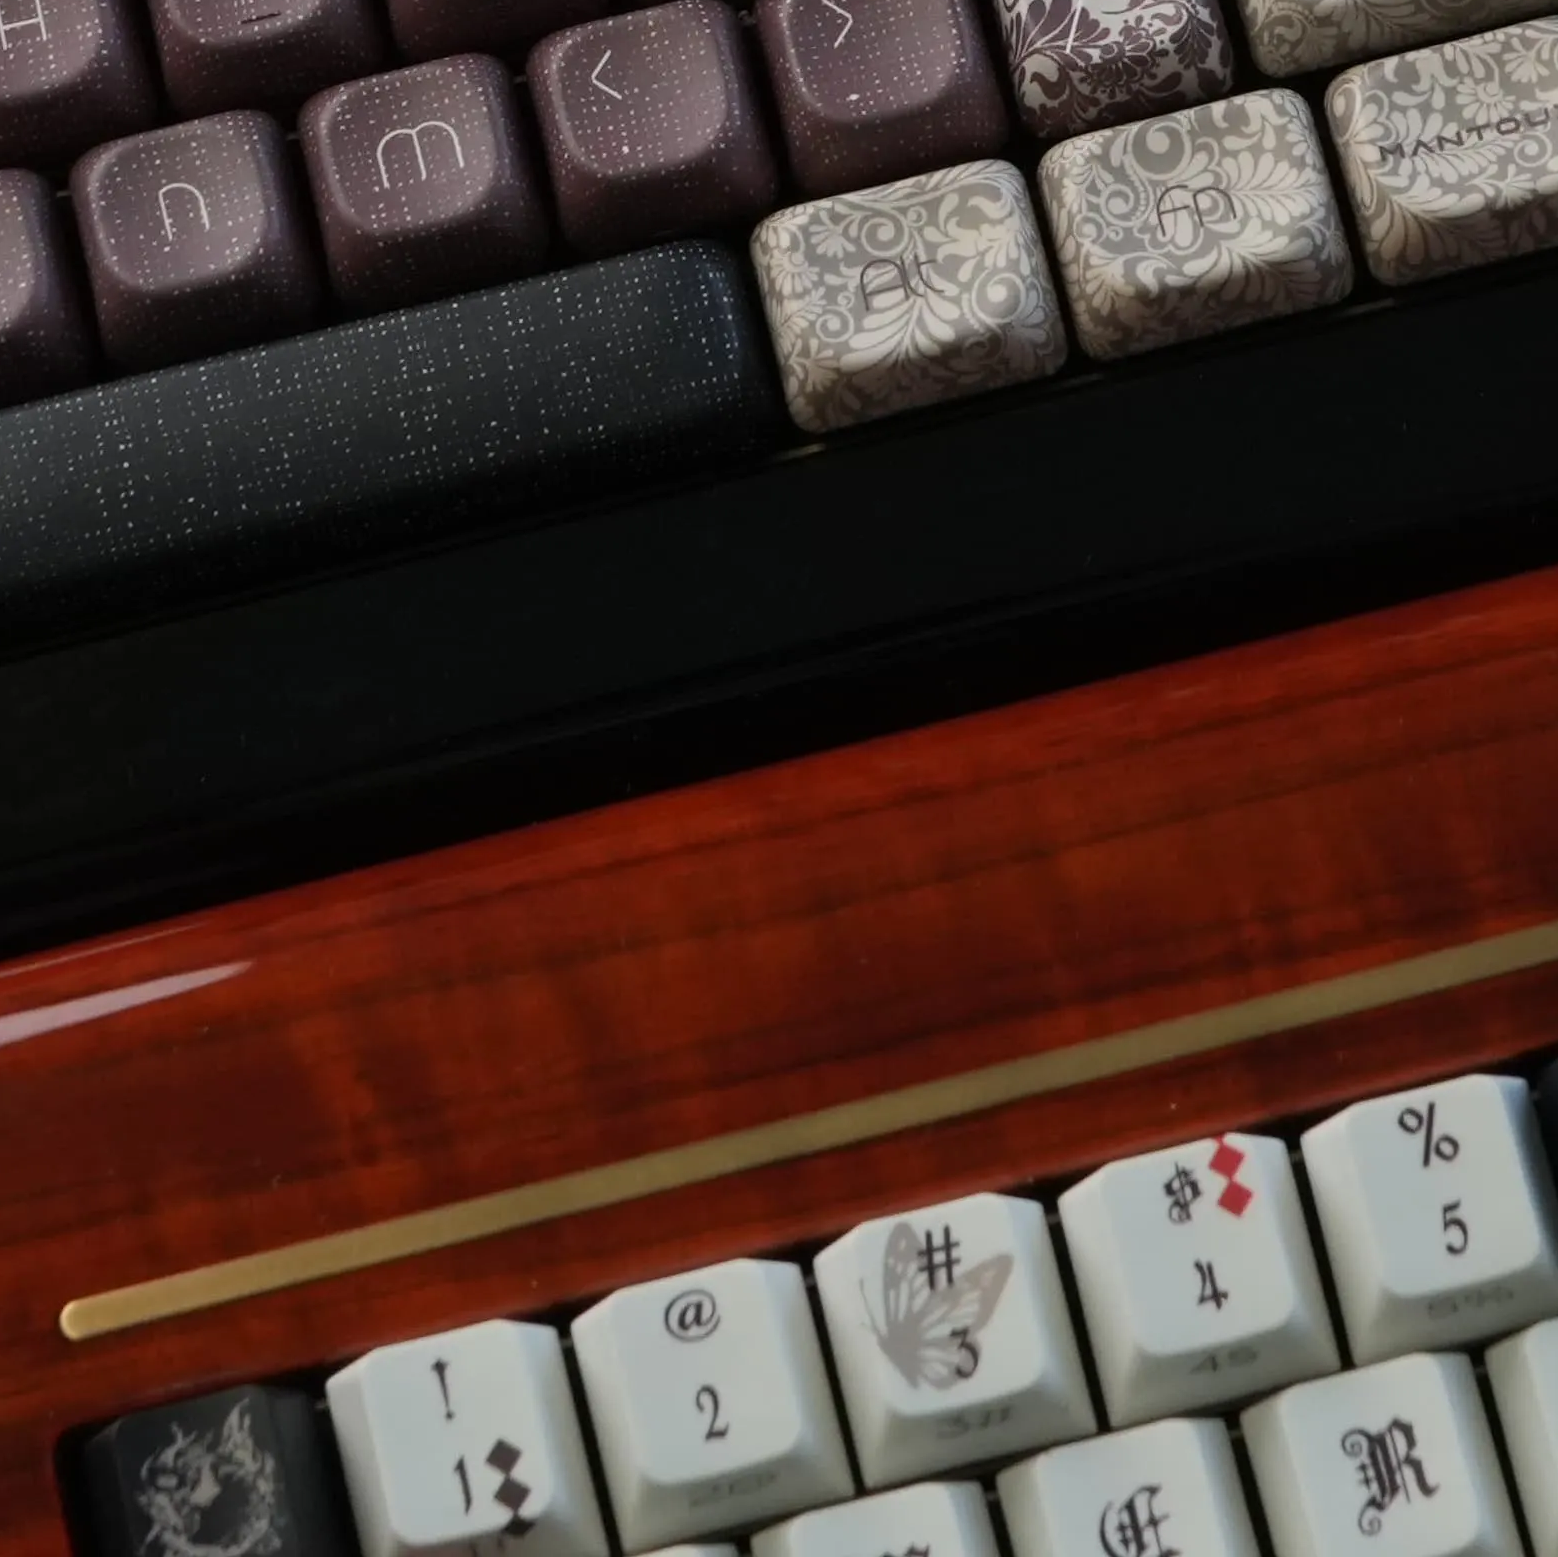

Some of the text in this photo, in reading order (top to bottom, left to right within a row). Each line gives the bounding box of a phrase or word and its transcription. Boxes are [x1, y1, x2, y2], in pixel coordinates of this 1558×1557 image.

[858, 257, 948, 313] Alt
[1441, 1201, 1470, 1256] 5
[696, 1385, 730, 1443] 2
[1340, 1417, 1439, 1537] R
